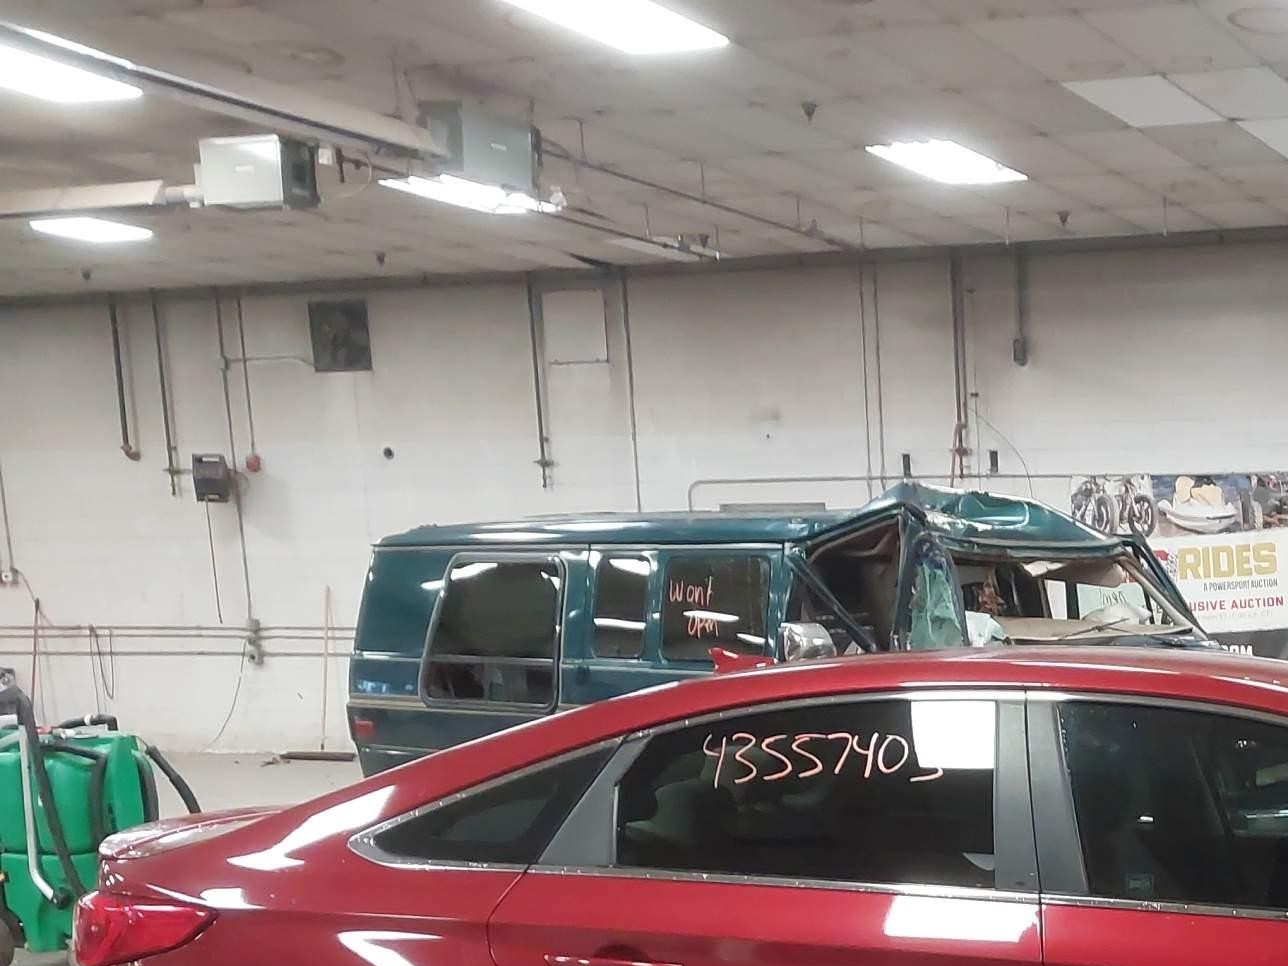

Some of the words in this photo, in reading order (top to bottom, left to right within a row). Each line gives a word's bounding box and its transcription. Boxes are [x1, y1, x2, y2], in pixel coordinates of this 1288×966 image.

[1178, 542, 1278, 580] RIDES
[1203, 583, 1208, 592] A
[1209, 581, 1250, 591] POWERSPORT
[1251, 578, 1278, 588] AUCTION
[1189, 600, 1226, 612] USIVE
[1231, 596, 1284, 609] AUCTION
